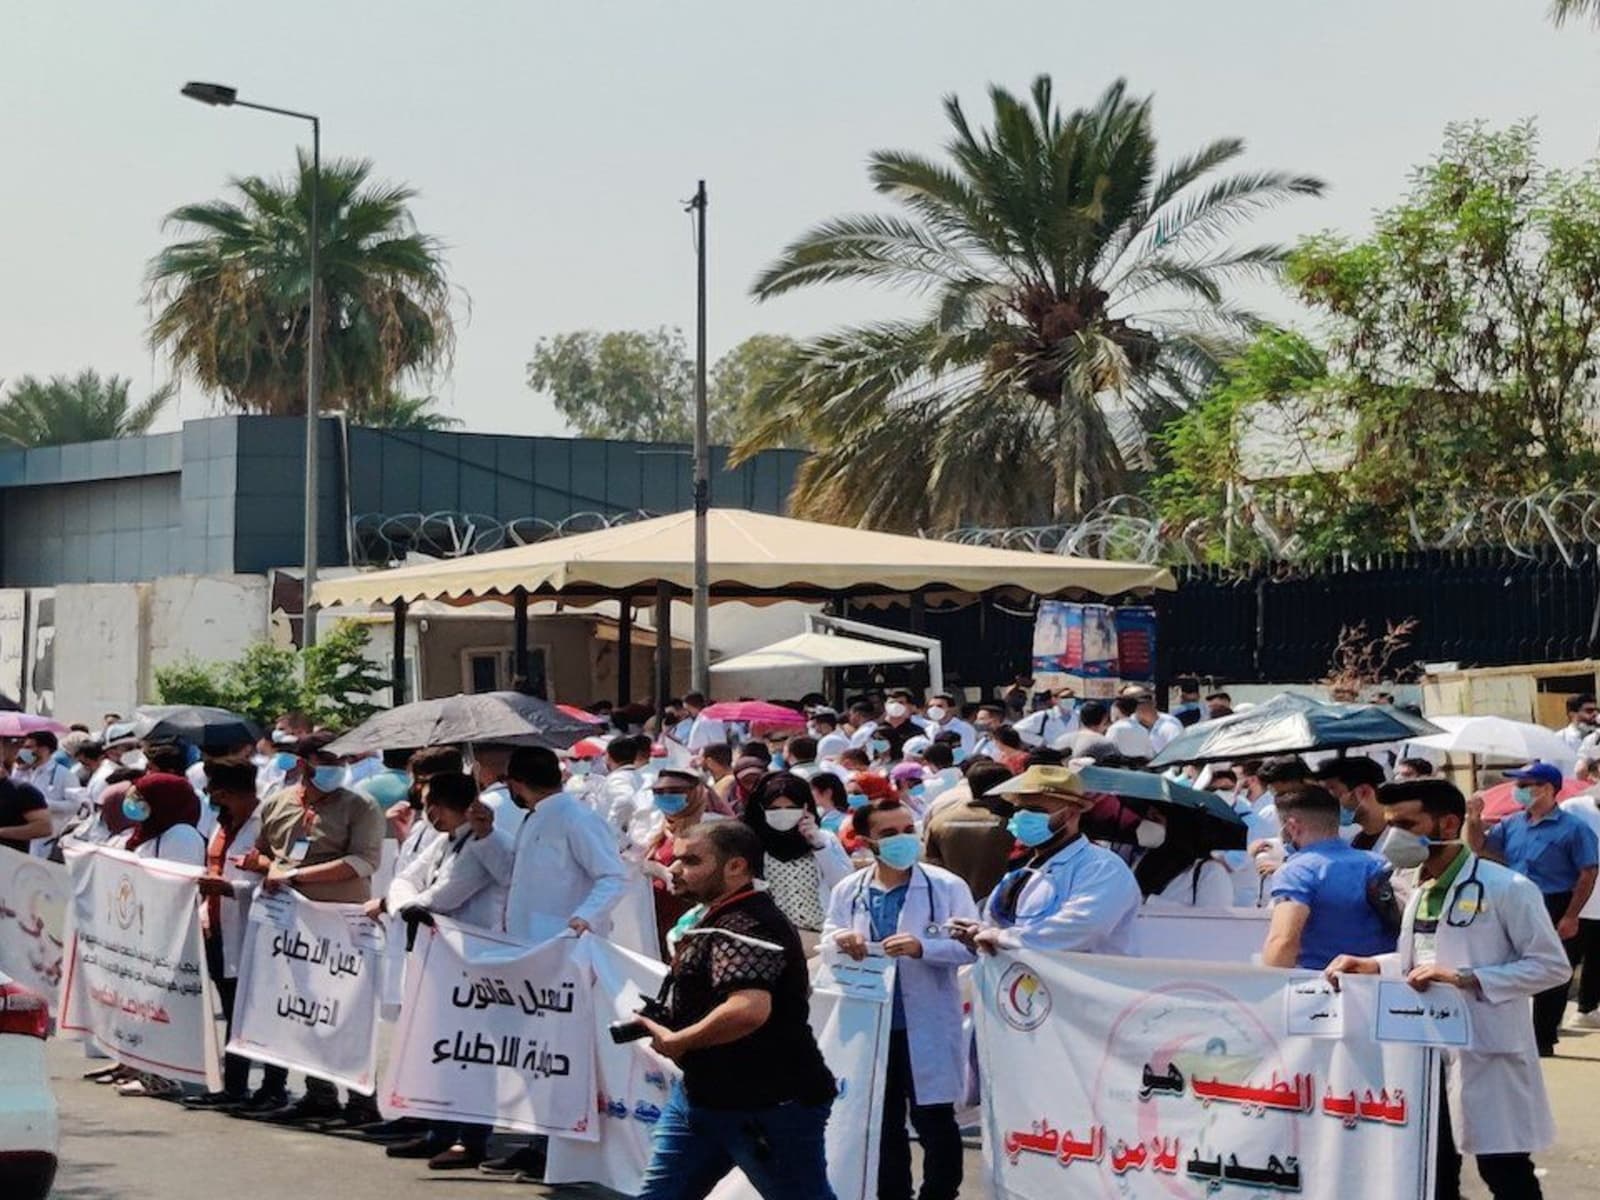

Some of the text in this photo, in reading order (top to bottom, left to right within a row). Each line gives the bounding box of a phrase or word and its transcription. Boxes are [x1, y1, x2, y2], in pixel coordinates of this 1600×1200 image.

[452, 970, 516, 1010] قانون
[1138, 1062, 1185, 1099] هو
[1190, 1071, 1315, 1115] الطبيب
[1004, 1118, 1106, 1167] الوطني
[1187, 1147, 1302, 1193] تهديد
